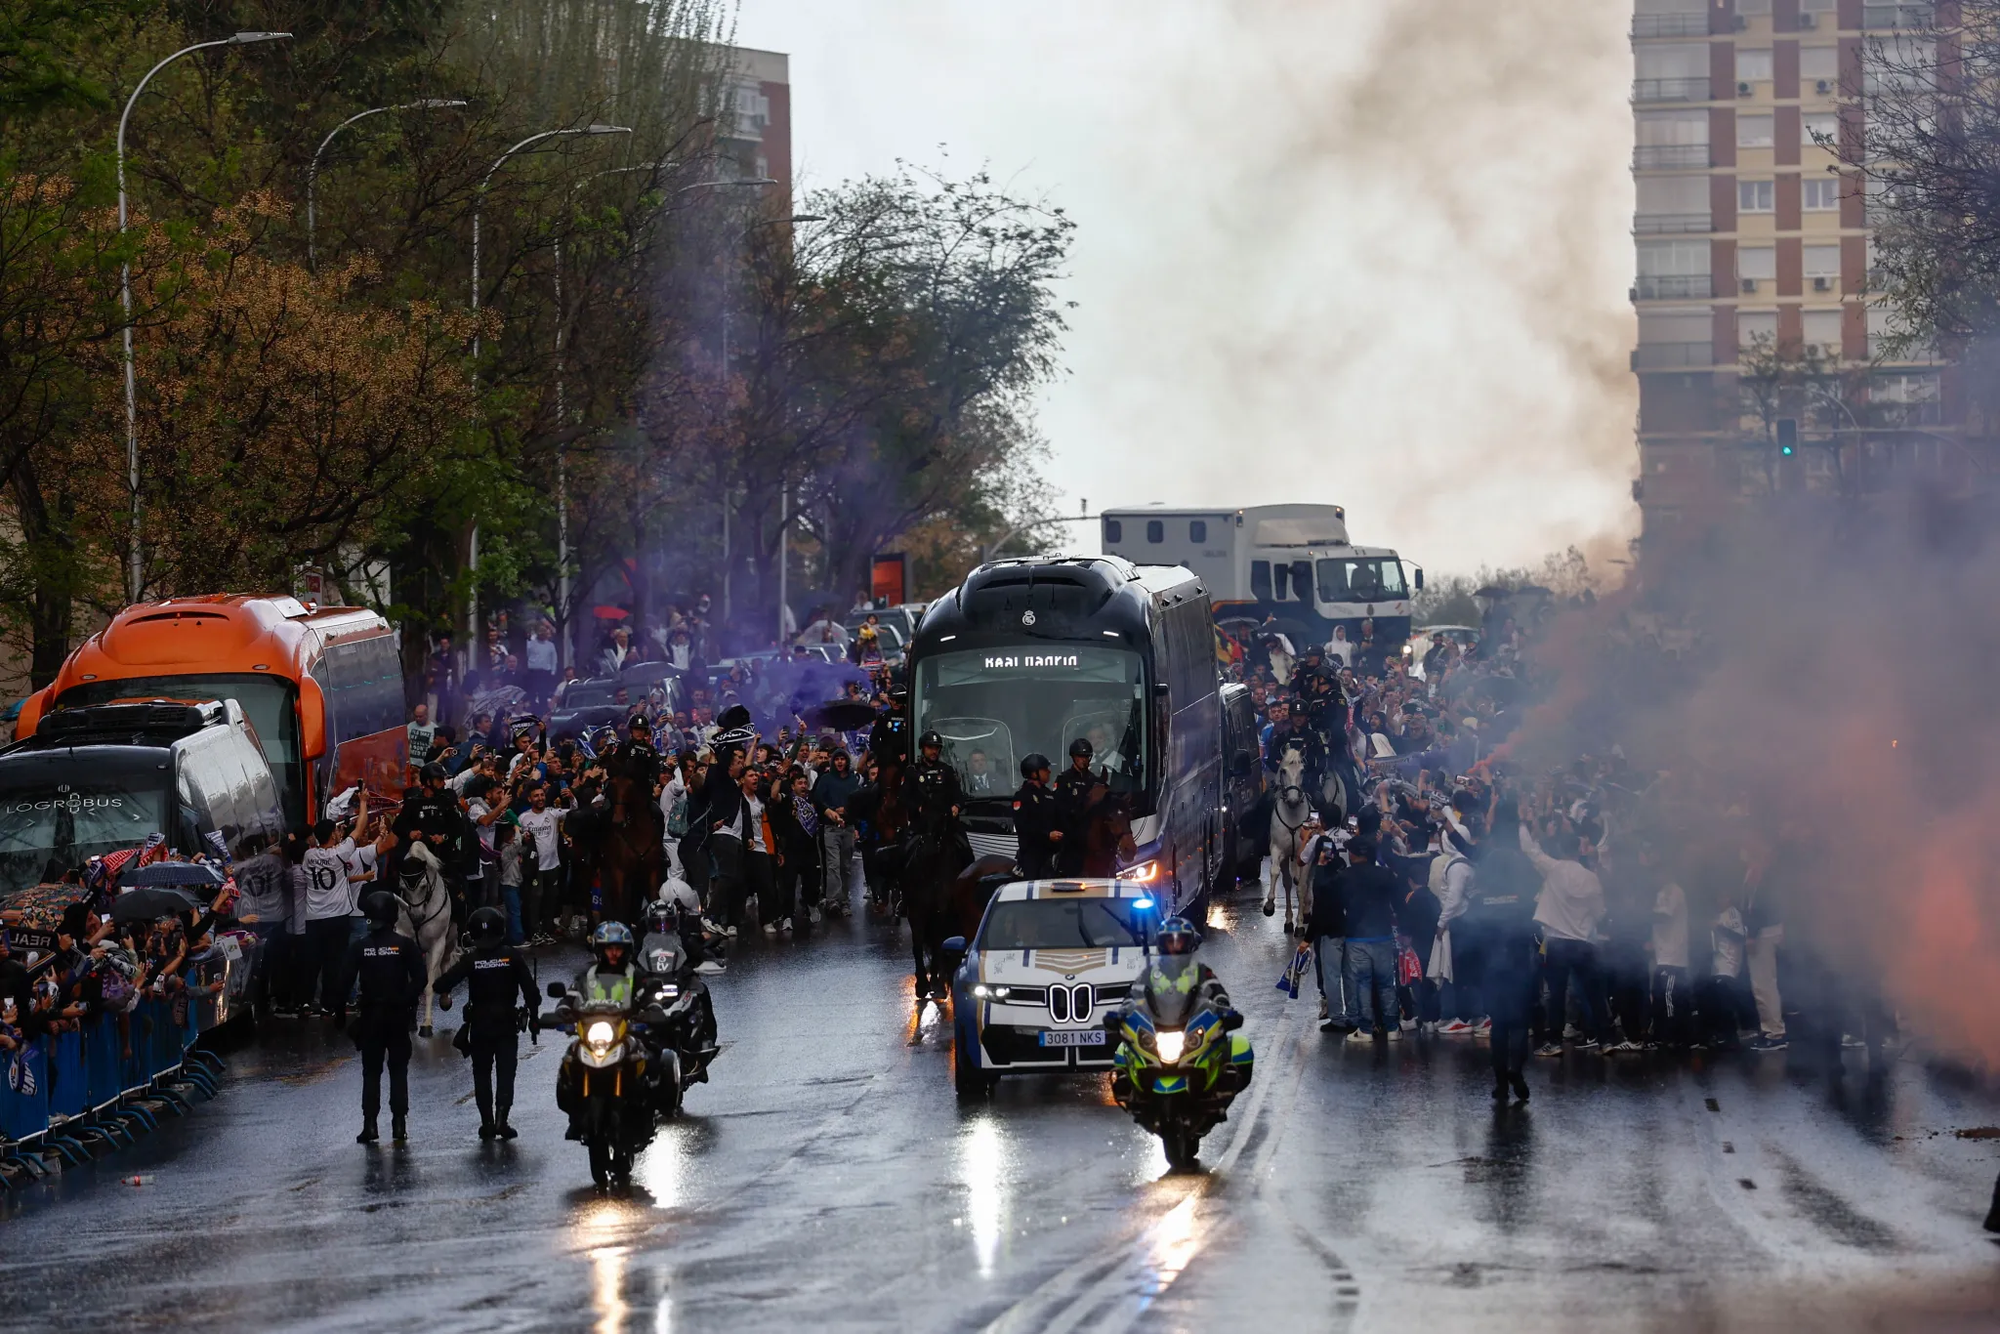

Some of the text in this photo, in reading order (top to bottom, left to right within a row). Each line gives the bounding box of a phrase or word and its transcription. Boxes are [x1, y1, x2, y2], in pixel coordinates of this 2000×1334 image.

[6, 798, 122, 814] LOGROBUS
[311, 866, 336, 891] 10
[1047, 1032, 1102, 1044] 3081 NKS
